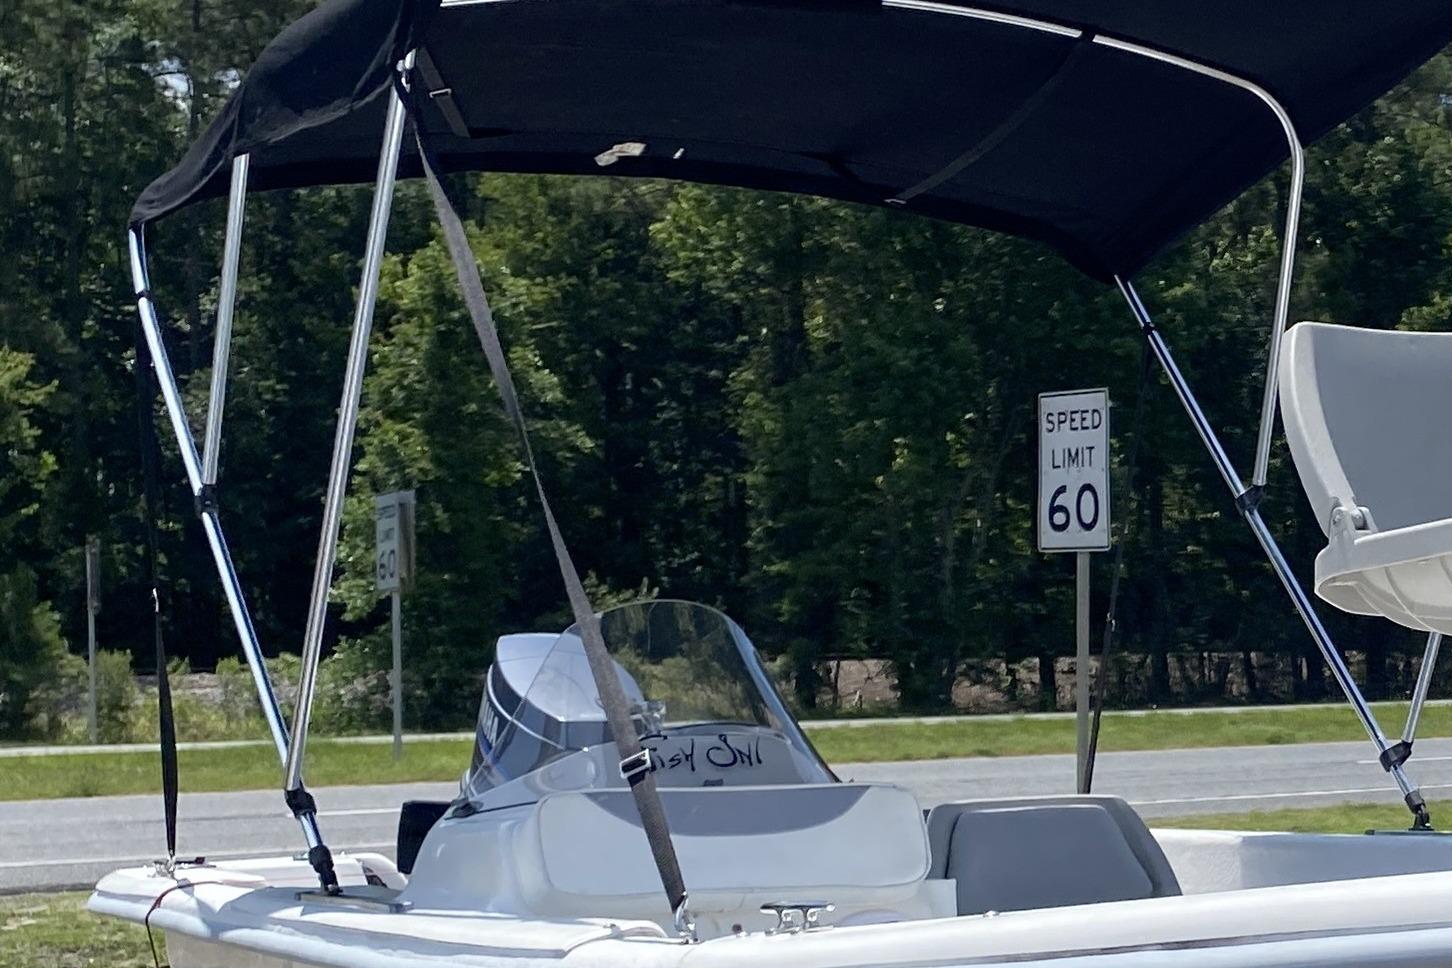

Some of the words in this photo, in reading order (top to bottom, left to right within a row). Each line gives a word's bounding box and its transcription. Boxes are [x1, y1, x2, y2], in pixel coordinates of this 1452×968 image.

[1046, 409, 1102, 433] SPEED
[1051, 446, 1095, 470] LIMIT
[1048, 482, 1099, 532] 60
